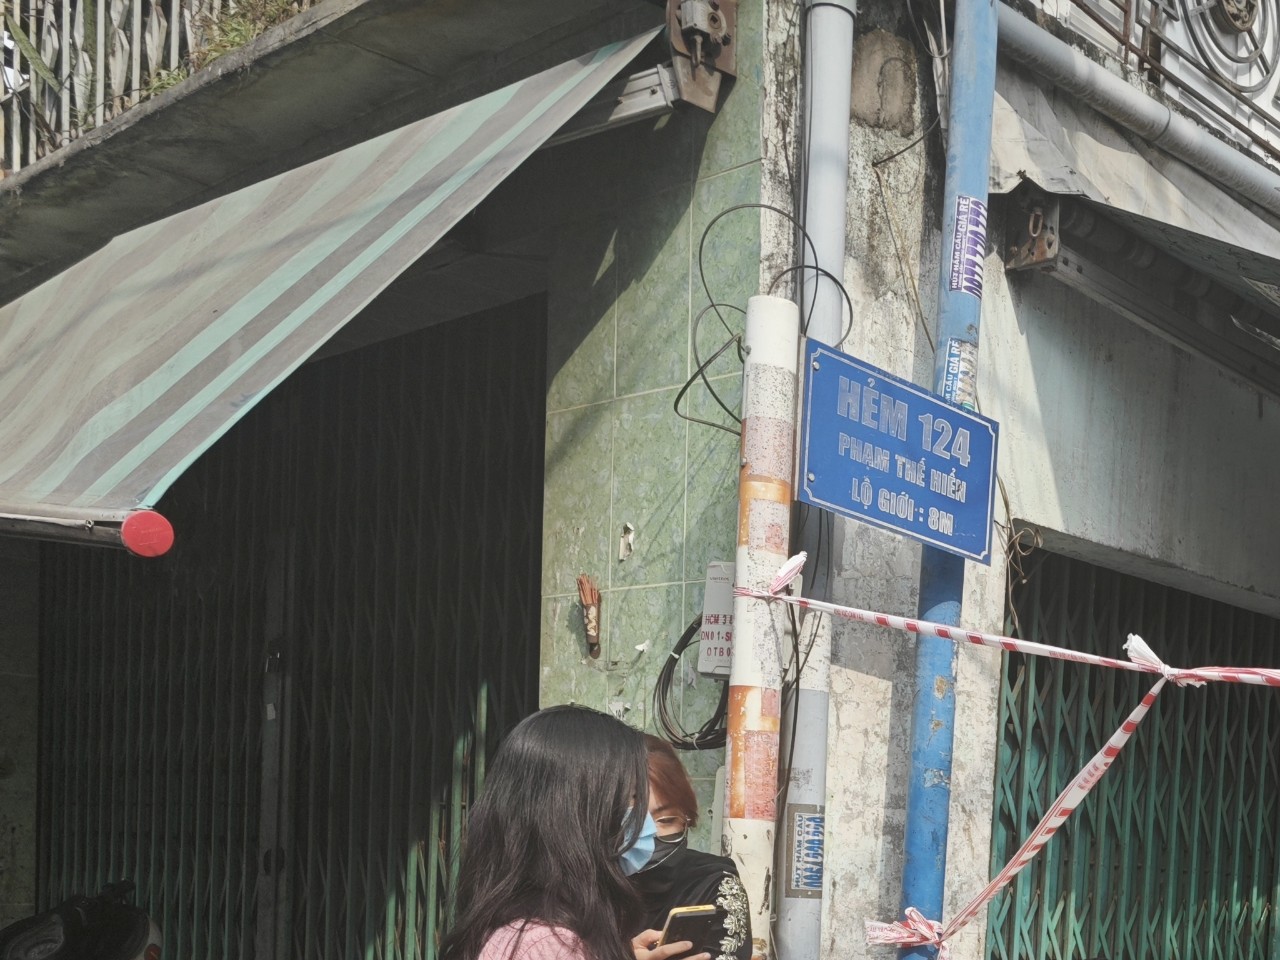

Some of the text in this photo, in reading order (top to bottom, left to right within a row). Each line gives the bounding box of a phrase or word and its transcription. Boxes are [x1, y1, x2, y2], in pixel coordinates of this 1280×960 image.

[837, 375, 909, 442] HẺM
[918, 413, 971, 468] 124
[838, 432, 967, 503] PHẠM THẾ HIỂN
[851, 475, 873, 510] LỘ
[928, 507, 954, 536] 8M
